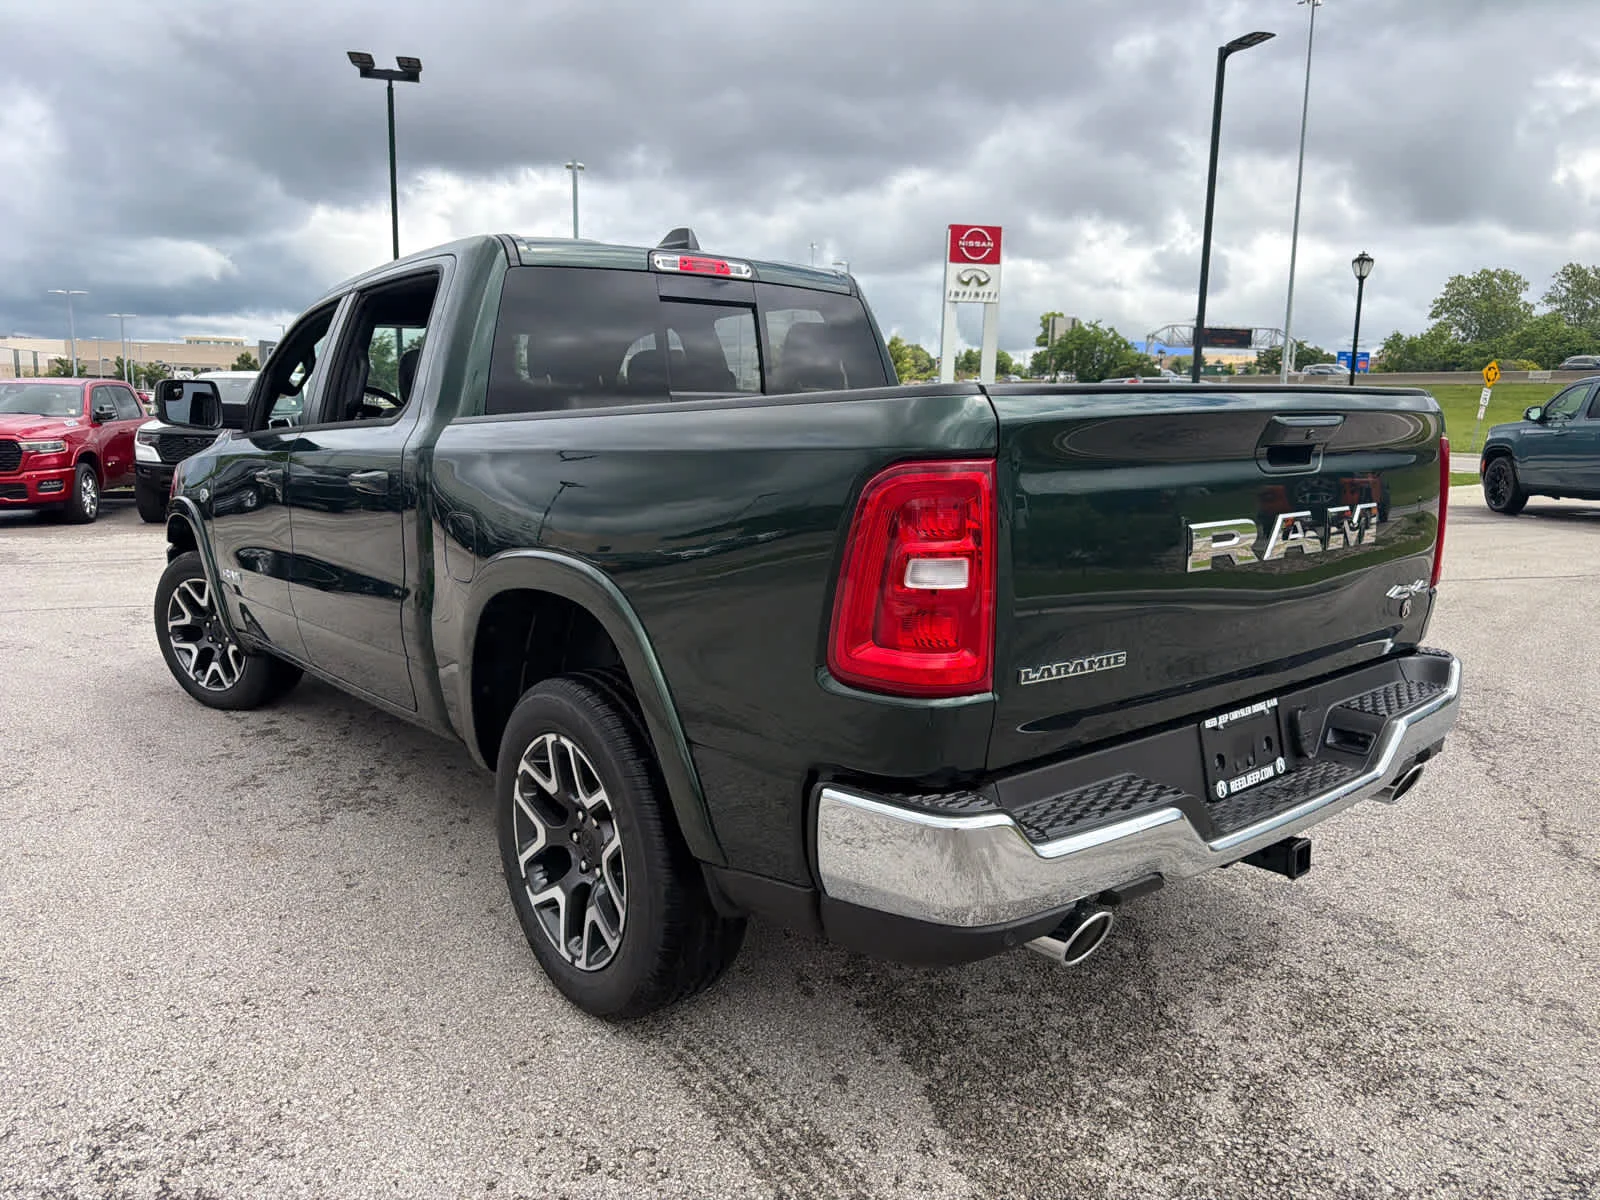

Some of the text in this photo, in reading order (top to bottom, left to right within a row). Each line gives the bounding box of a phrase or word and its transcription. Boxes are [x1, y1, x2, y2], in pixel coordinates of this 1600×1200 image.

[959, 240, 994, 248] NISSAN
[949, 290, 997, 299] INFINITI
[1186, 503, 1377, 572] RAM
[1020, 651, 1127, 685] LARAMIE
[1218, 714, 1229, 725] JEEP
[1229, 706, 1252, 721] CHRYSLER
[1252, 701, 1266, 713] DODGE
[1267, 698, 1278, 708] RAM
